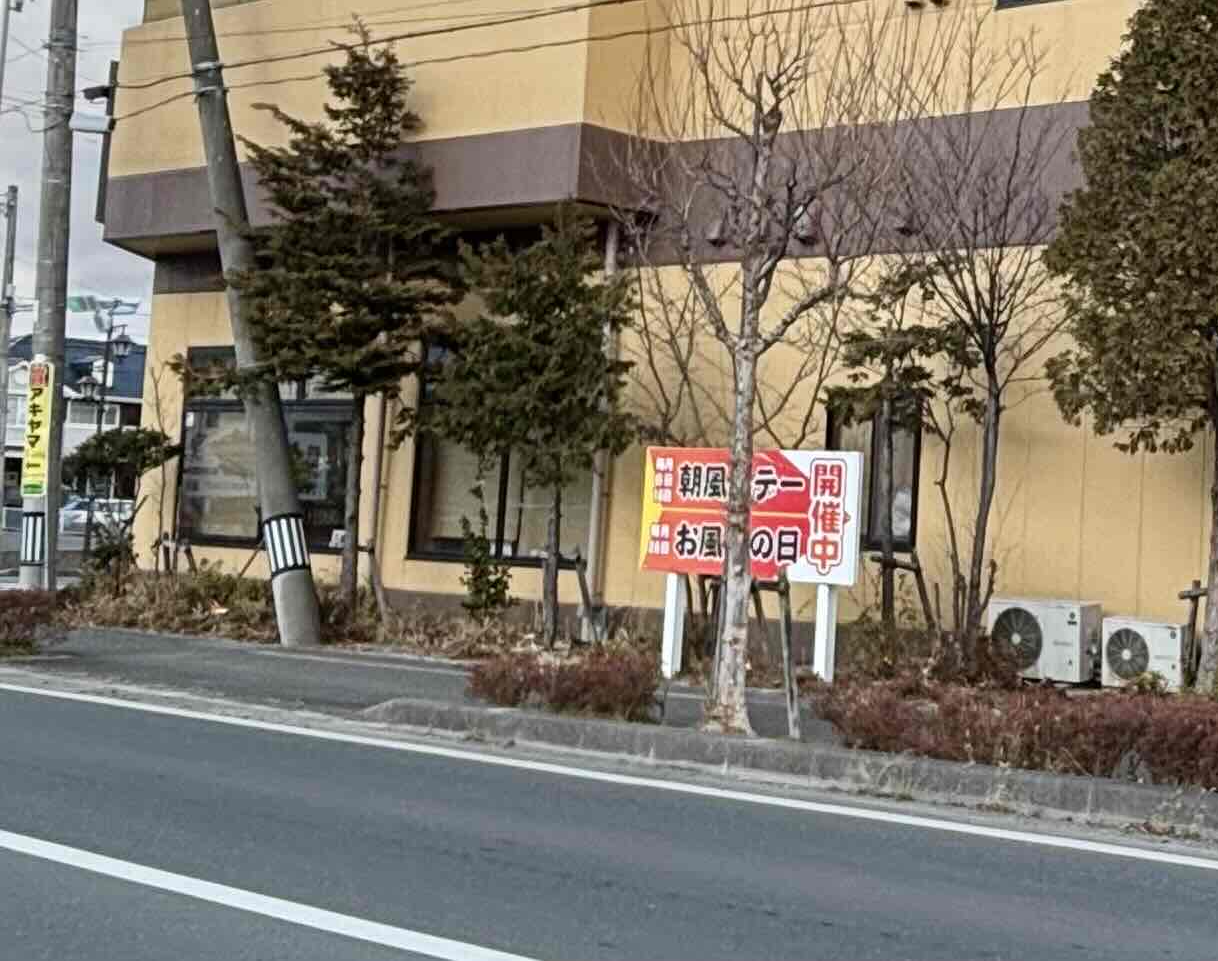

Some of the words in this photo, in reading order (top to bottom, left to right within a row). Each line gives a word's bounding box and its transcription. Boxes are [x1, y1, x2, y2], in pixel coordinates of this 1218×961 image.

[679, 465, 803, 500] 朝風デー
[812, 463, 843, 570] 開催中
[675, 524, 799, 564] お風の日
